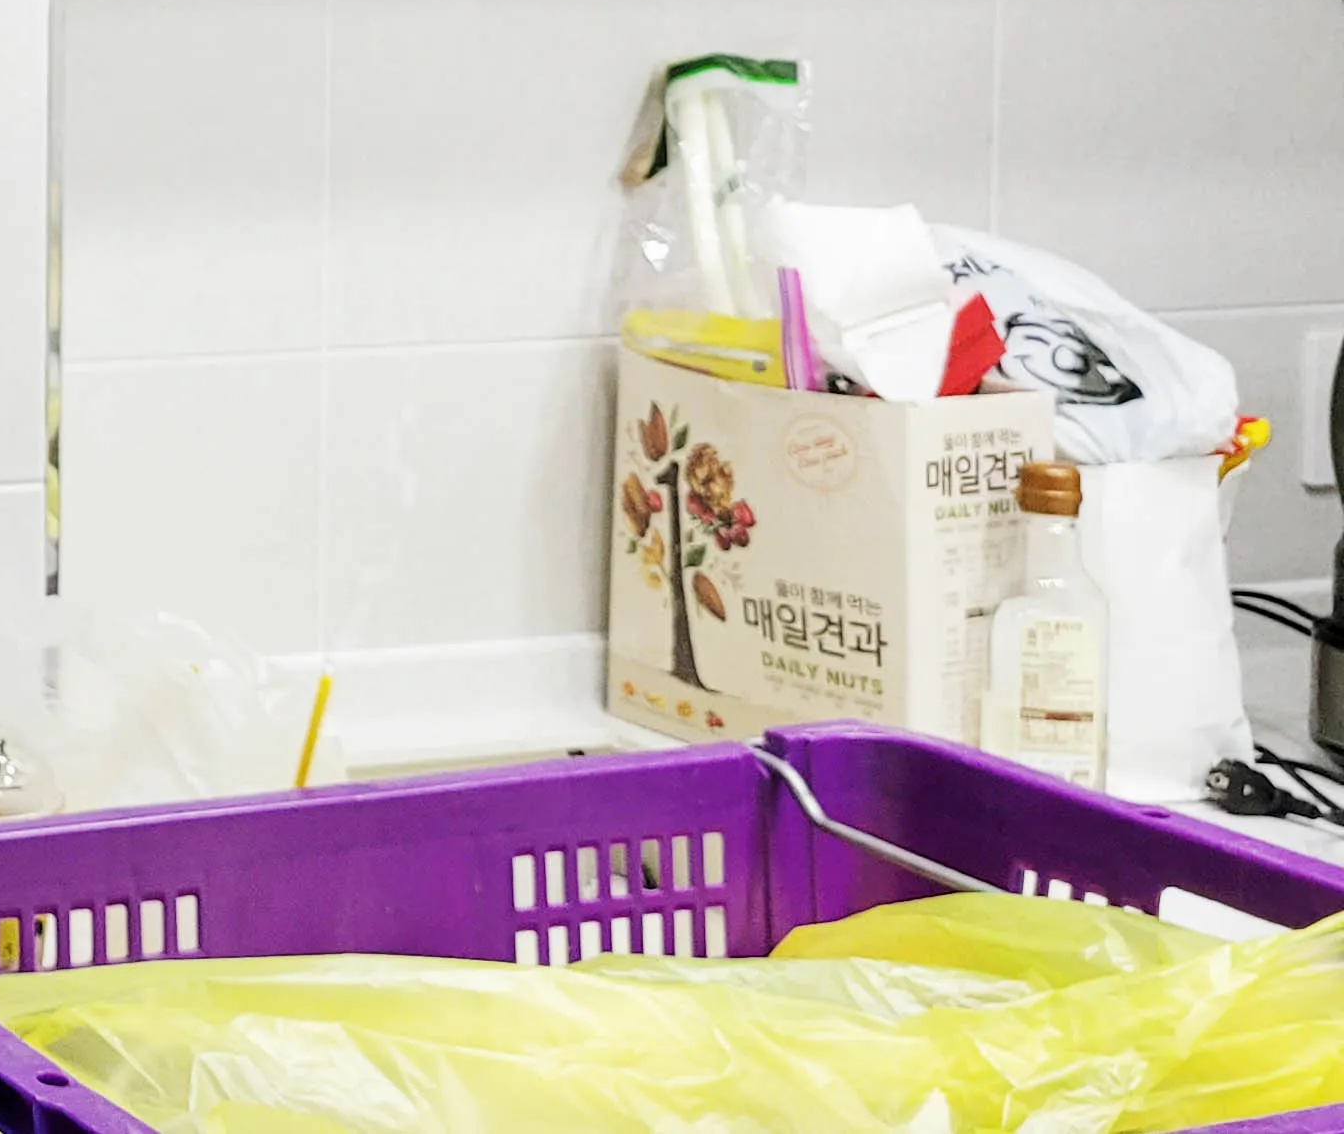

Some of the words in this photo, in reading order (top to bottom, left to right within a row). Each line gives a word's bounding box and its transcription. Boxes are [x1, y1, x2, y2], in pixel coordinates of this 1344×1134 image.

[935, 502, 982, 521] DAILY
[743, 596, 888, 668] 매일견과
[761, 650, 820, 681] DAILY
[826, 667, 884, 695] NUTS
